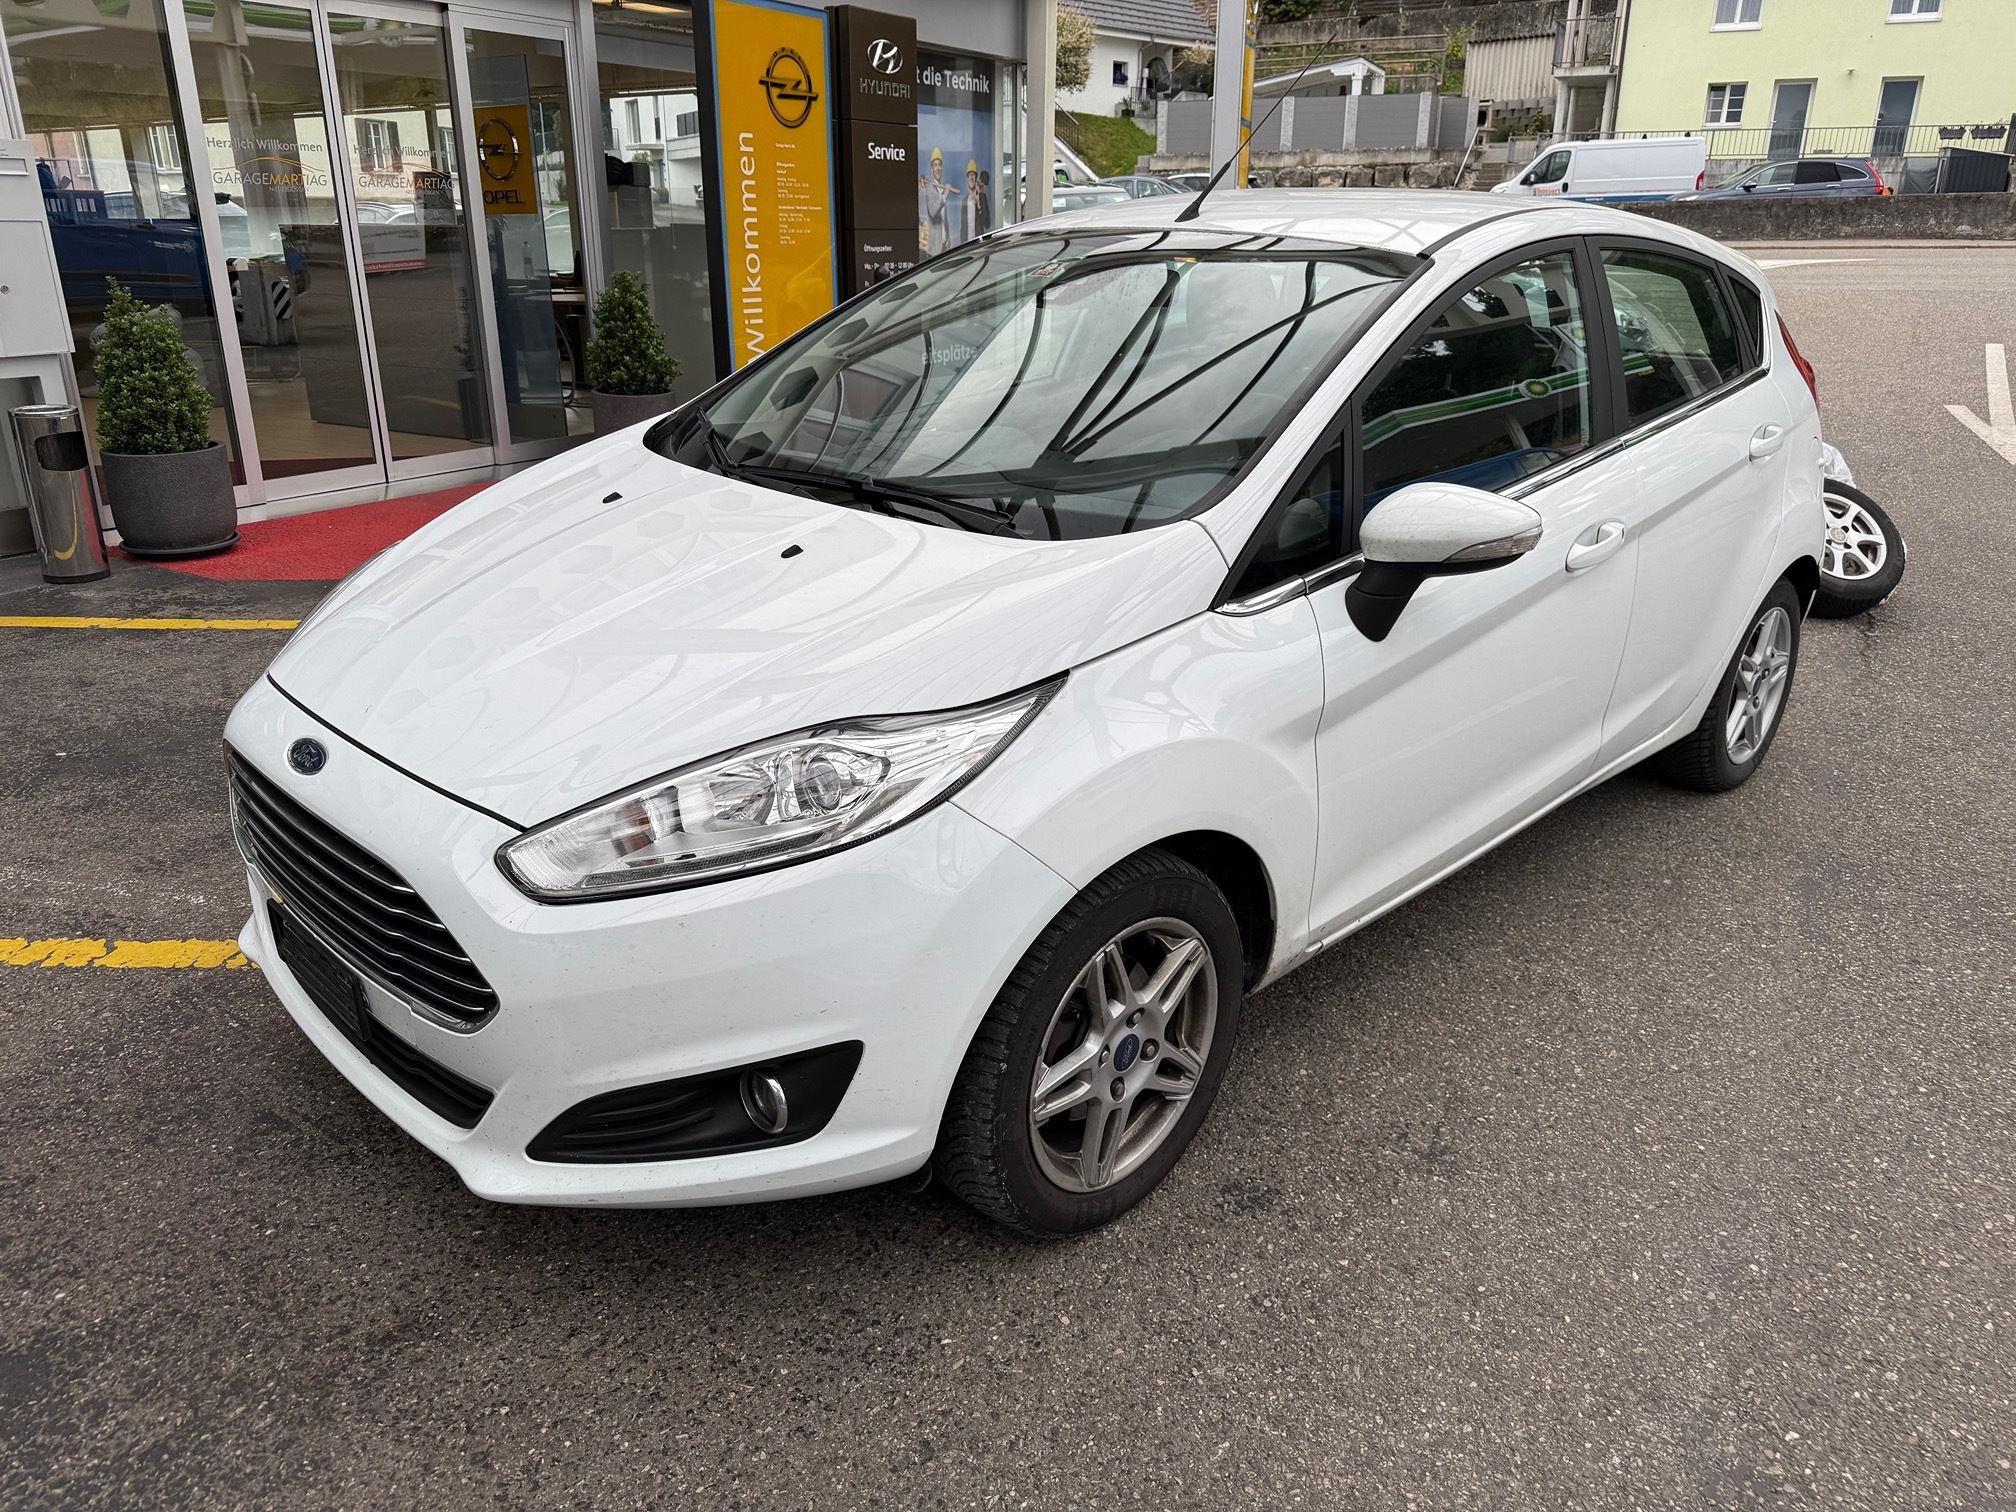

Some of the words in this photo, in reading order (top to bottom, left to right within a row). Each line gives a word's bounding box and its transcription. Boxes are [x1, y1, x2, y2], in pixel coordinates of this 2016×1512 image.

[859, 77, 911, 99] HYUNDAI
[922, 66, 942, 87] die
[944, 69, 990, 94] Technik
[206, 136, 255, 151] Herzlich
[256, 138, 323, 152] Willkommen
[867, 142, 906, 161] Service
[483, 189, 526, 205] OPEL
[739, 131, 766, 366] Willkommen
[921, 343, 978, 367] eitsplätze
